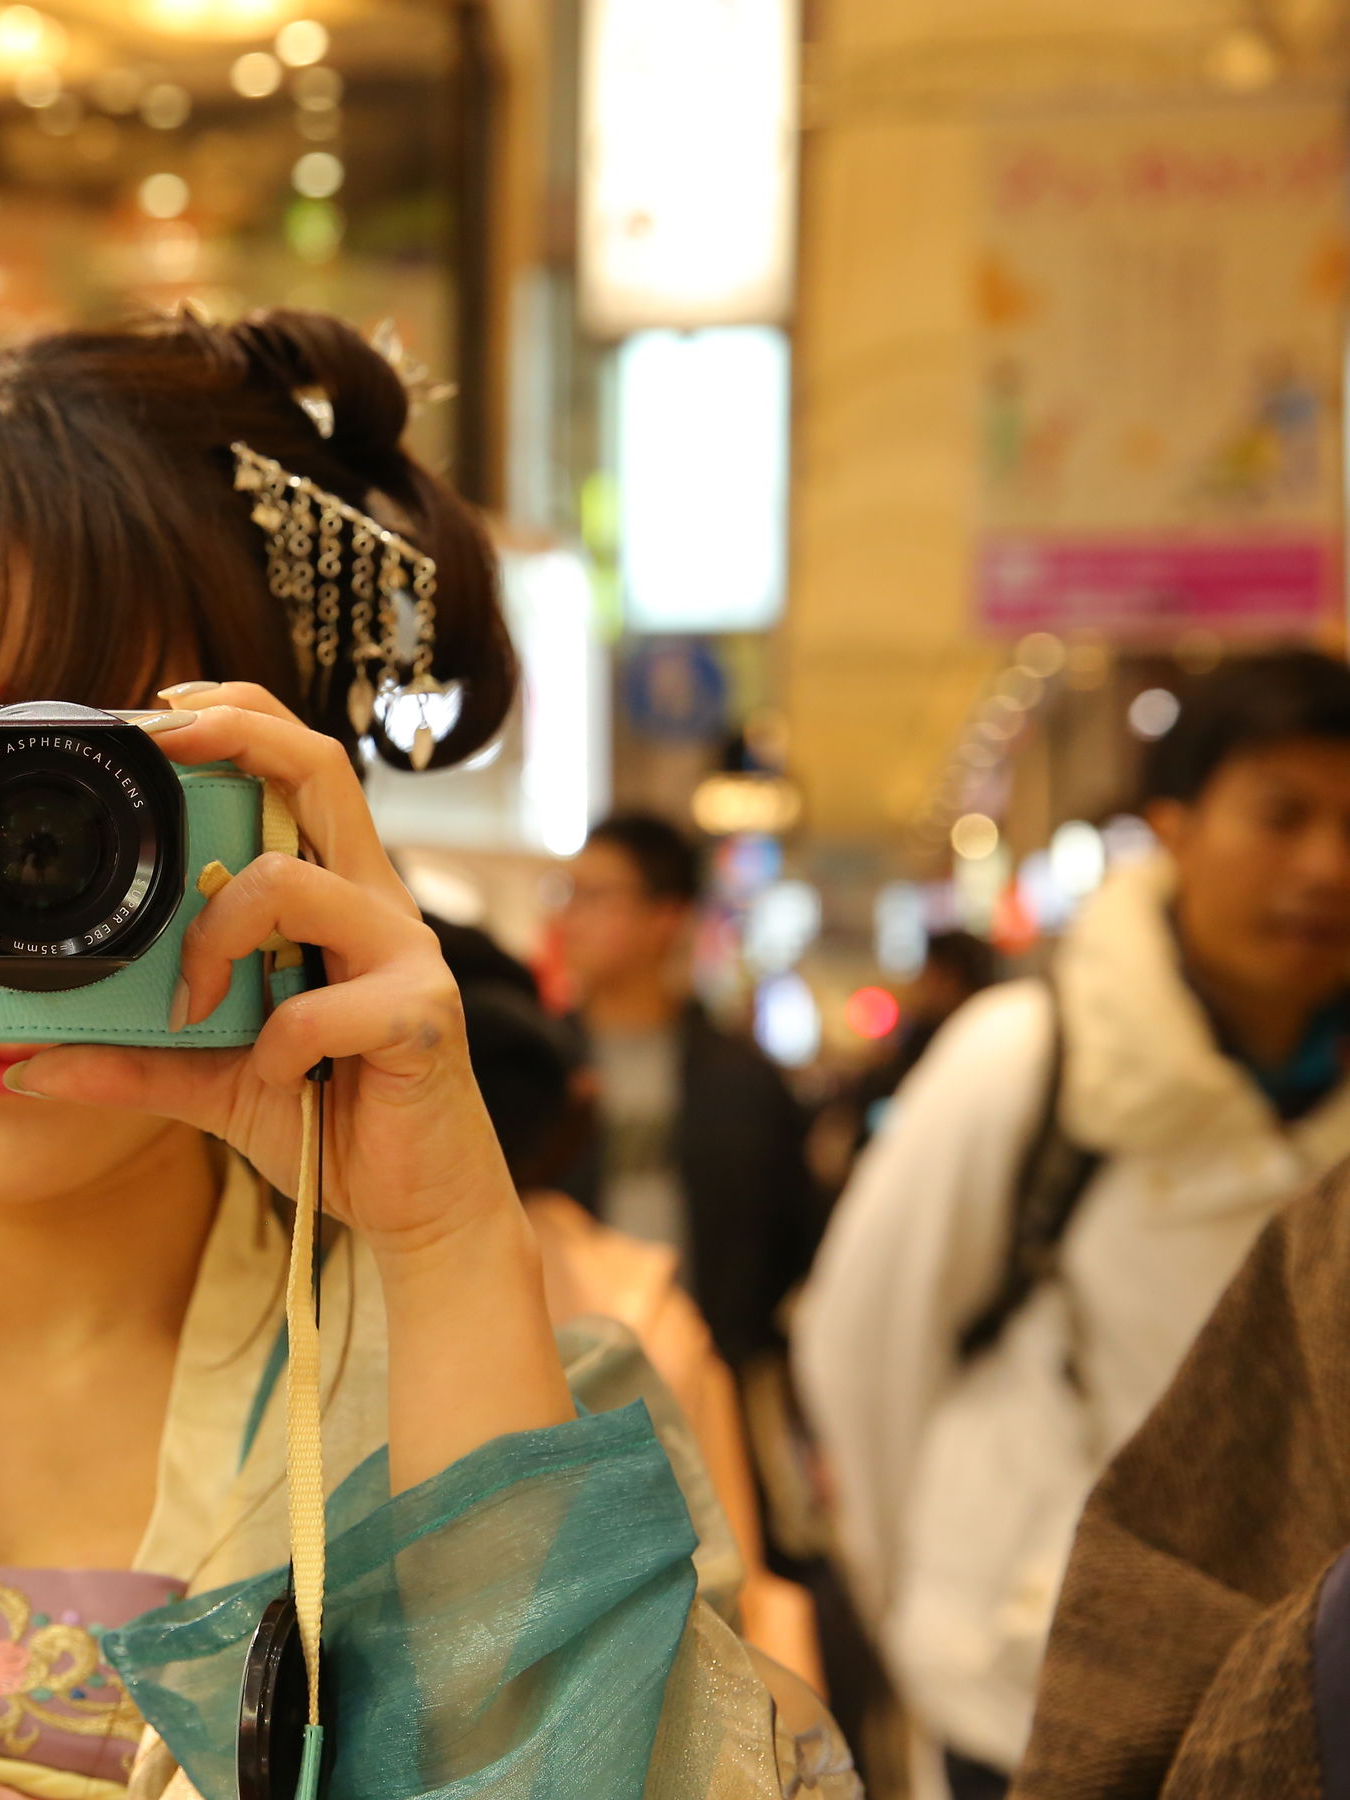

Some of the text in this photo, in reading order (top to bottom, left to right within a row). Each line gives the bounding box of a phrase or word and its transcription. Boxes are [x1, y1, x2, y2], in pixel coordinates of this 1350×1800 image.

[6, 737, 111, 770] ASPHERICAL
[114, 768, 144, 809] LENS
[112, 878, 146, 924] SUPER
[84, 924, 111, 945] EBC
